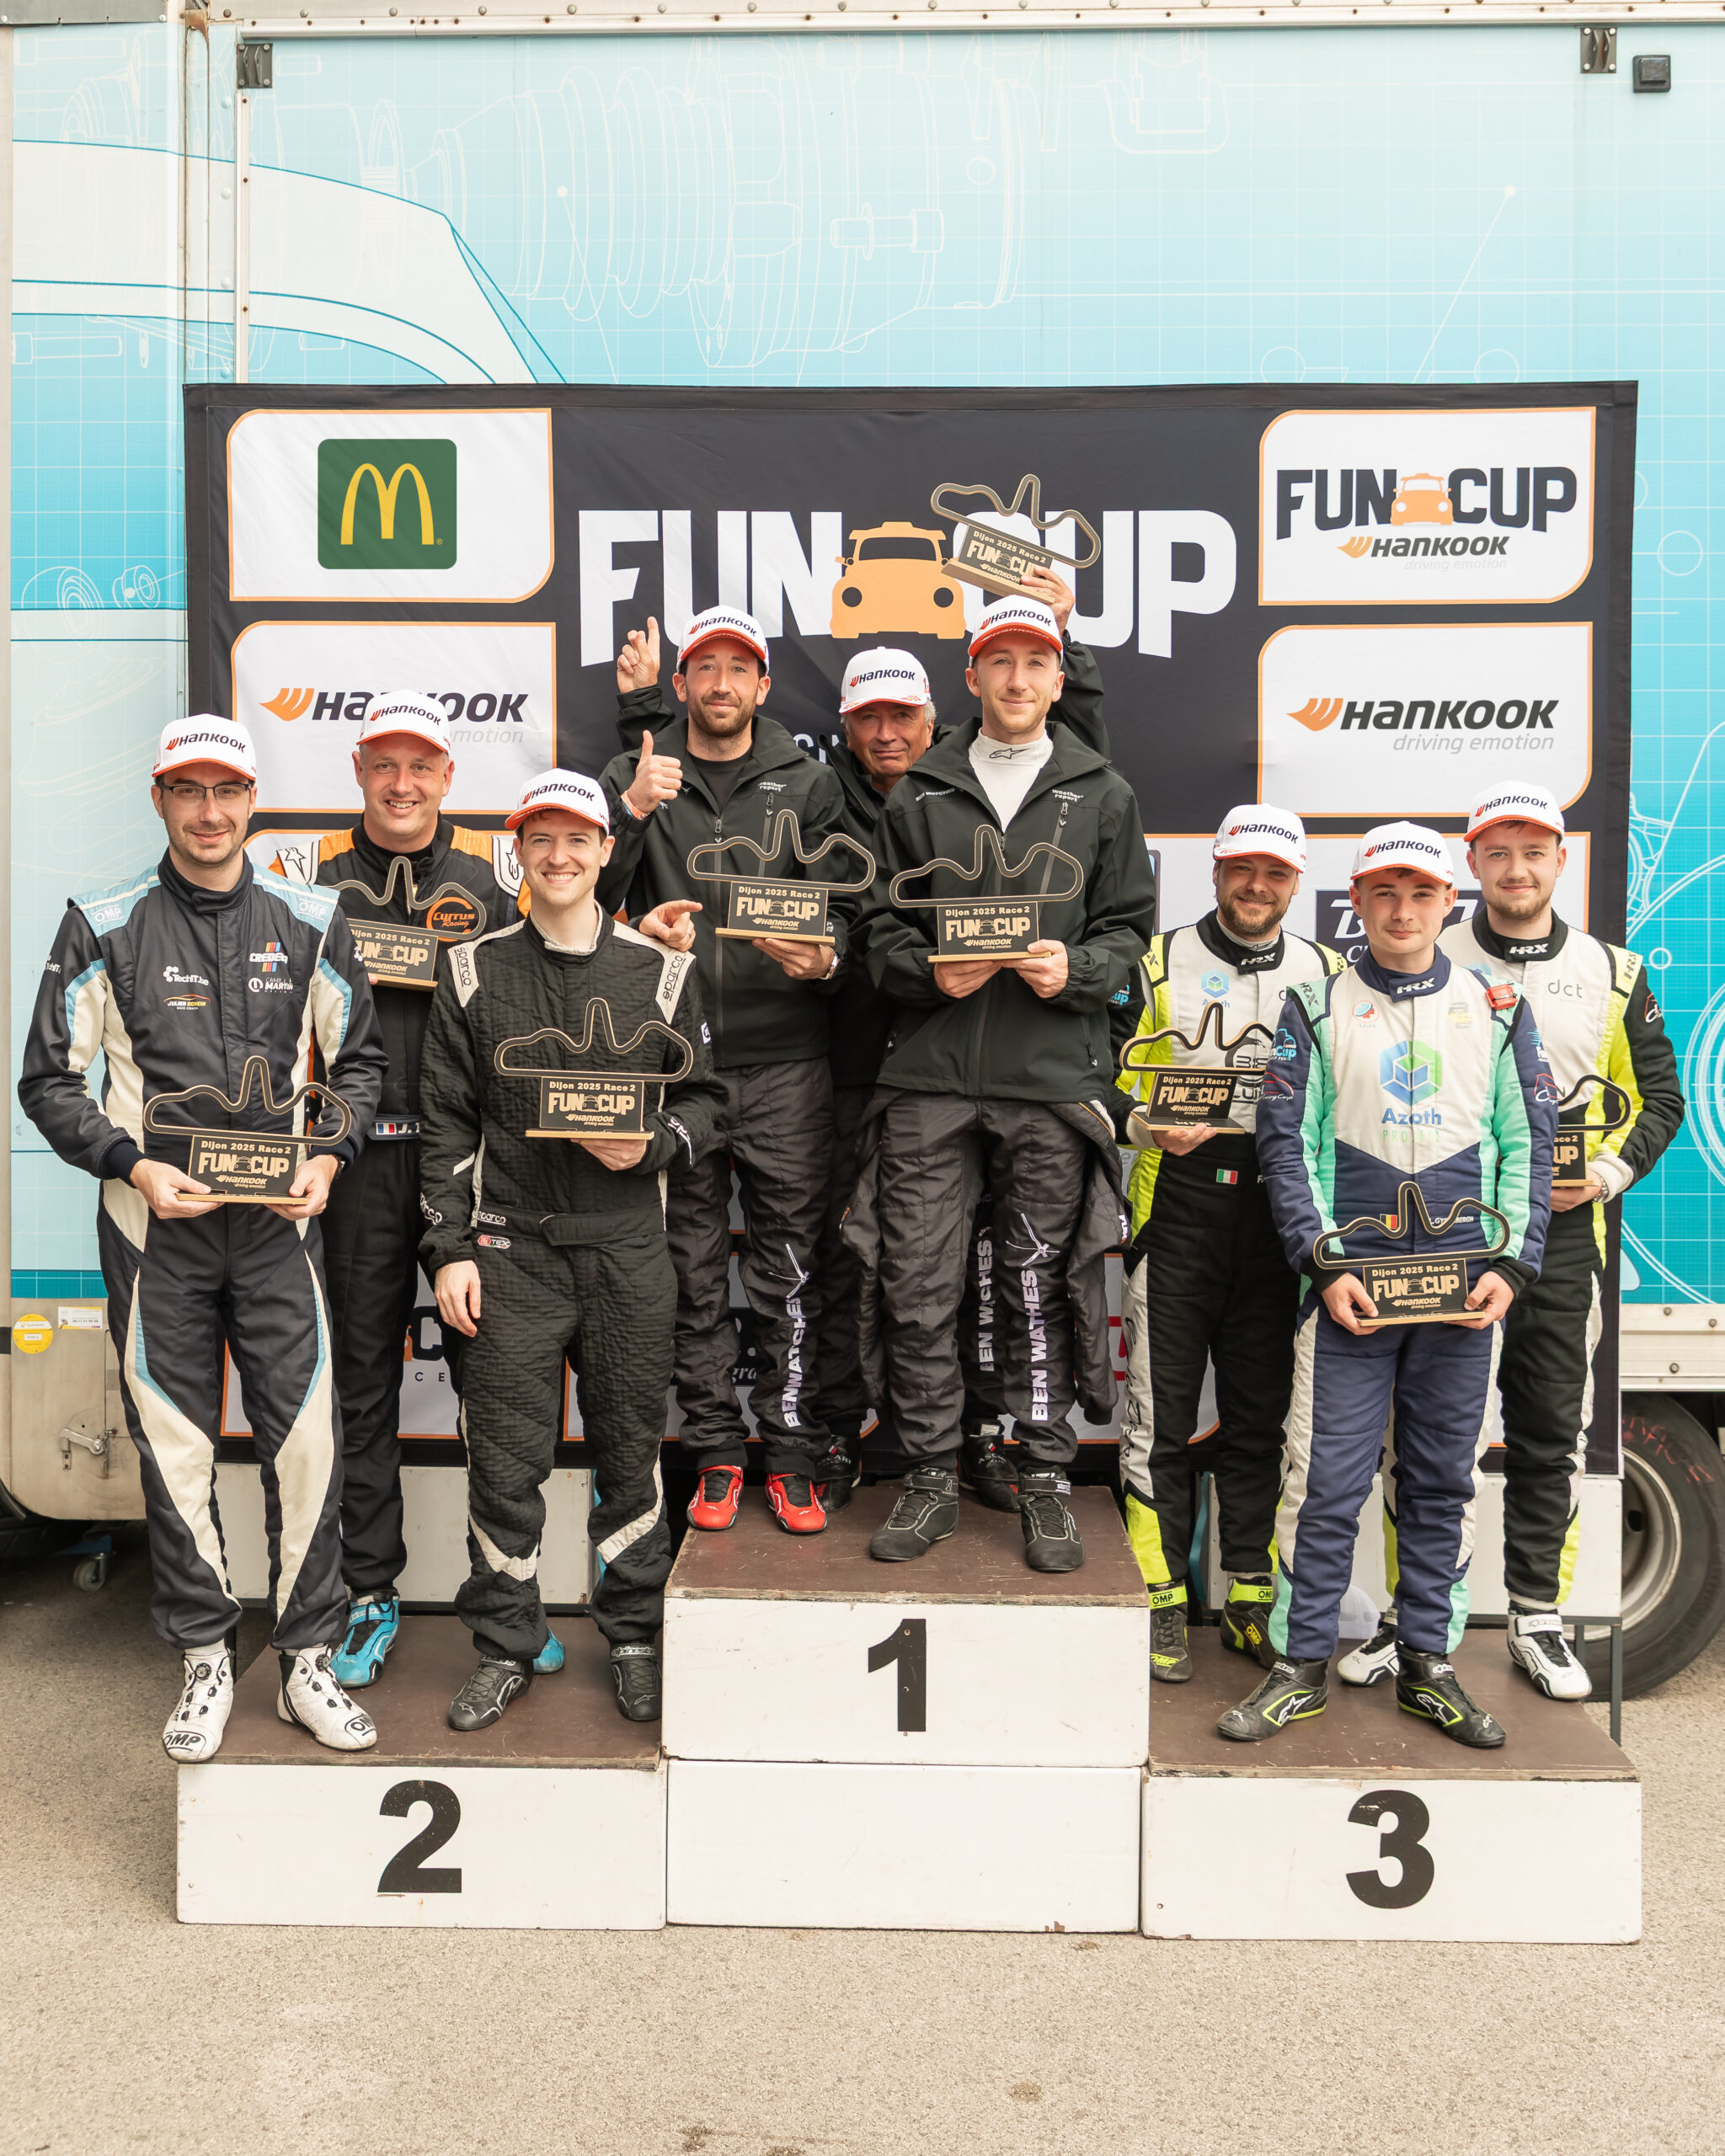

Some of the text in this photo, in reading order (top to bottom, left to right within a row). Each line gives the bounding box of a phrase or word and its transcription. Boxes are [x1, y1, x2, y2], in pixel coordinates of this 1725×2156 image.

[1276, 467, 1577, 541] FUN CUP
[973, 531, 995, 544] Dijon
[996, 540, 1017, 552] 2025
[1019, 549, 1039, 562] Race
[966, 540, 1035, 579] FUN CU
[1404, 558, 1507, 572] driving emotion
[579, 510, 842, 667] FUN
[450, 727, 524, 744] motion
[1392, 734, 1554, 754] driving emotion
[739, 886, 762, 895] Dijon
[765, 888, 788, 897] 2025
[790, 890, 814, 899] Race
[94, 907, 121, 922] OMP
[298, 901, 327, 917] OMP
[736, 896, 820, 921] FUN CUP
[973, 907, 996, 915] 2025
[375, 931, 398, 942] 2025
[400, 936, 424, 944] Race
[945, 917, 1030, 942] FUN CUP
[356, 941, 429, 966] UN CUP
[1509, 942, 1549, 954] HRX
[454, 947, 472, 987] sparco
[1241, 953, 1276, 966] HRX
[662, 955, 684, 1001] sparco
[1397, 978, 1435, 995] HRX
[1547, 979, 1583, 999] dct
[549, 1081, 574, 1091] Dijon
[577, 1082, 601, 1091] 2025
[604, 1083, 628, 1091] Race
[1157, 1086, 1190, 1105] FUN
[1198, 1087, 1229, 1106] CUP
[548, 1092, 635, 1115] FUN CUP
[1381, 1107, 1442, 1125] Azoth
[201, 1140, 227, 1150] Dijon
[231, 1143, 255, 1151] 2025
[258, 1145, 283, 1154] Race
[1553, 1145, 1579, 1165] UP
[198, 1152, 290, 1178] FUN CUP
[1372, 1267, 1397, 1278] Dijon
[1400, 1266, 1423, 1274] 2025
[1426, 1264, 1450, 1273] Race
[1372, 1274, 1460, 1302] FUN CUP
[1030, 1369, 1049, 1422] BEN
[1152, 1593, 1173, 1605] OMP
[1258, 1590, 1273, 1599] OM
[1246, 1625, 1261, 1646] OMP
[868, 1618, 927, 1732] 1
[164, 1733, 201, 1746] OMP
[377, 1780, 462, 1893] 2
[1346, 1790, 1434, 1909] 3
